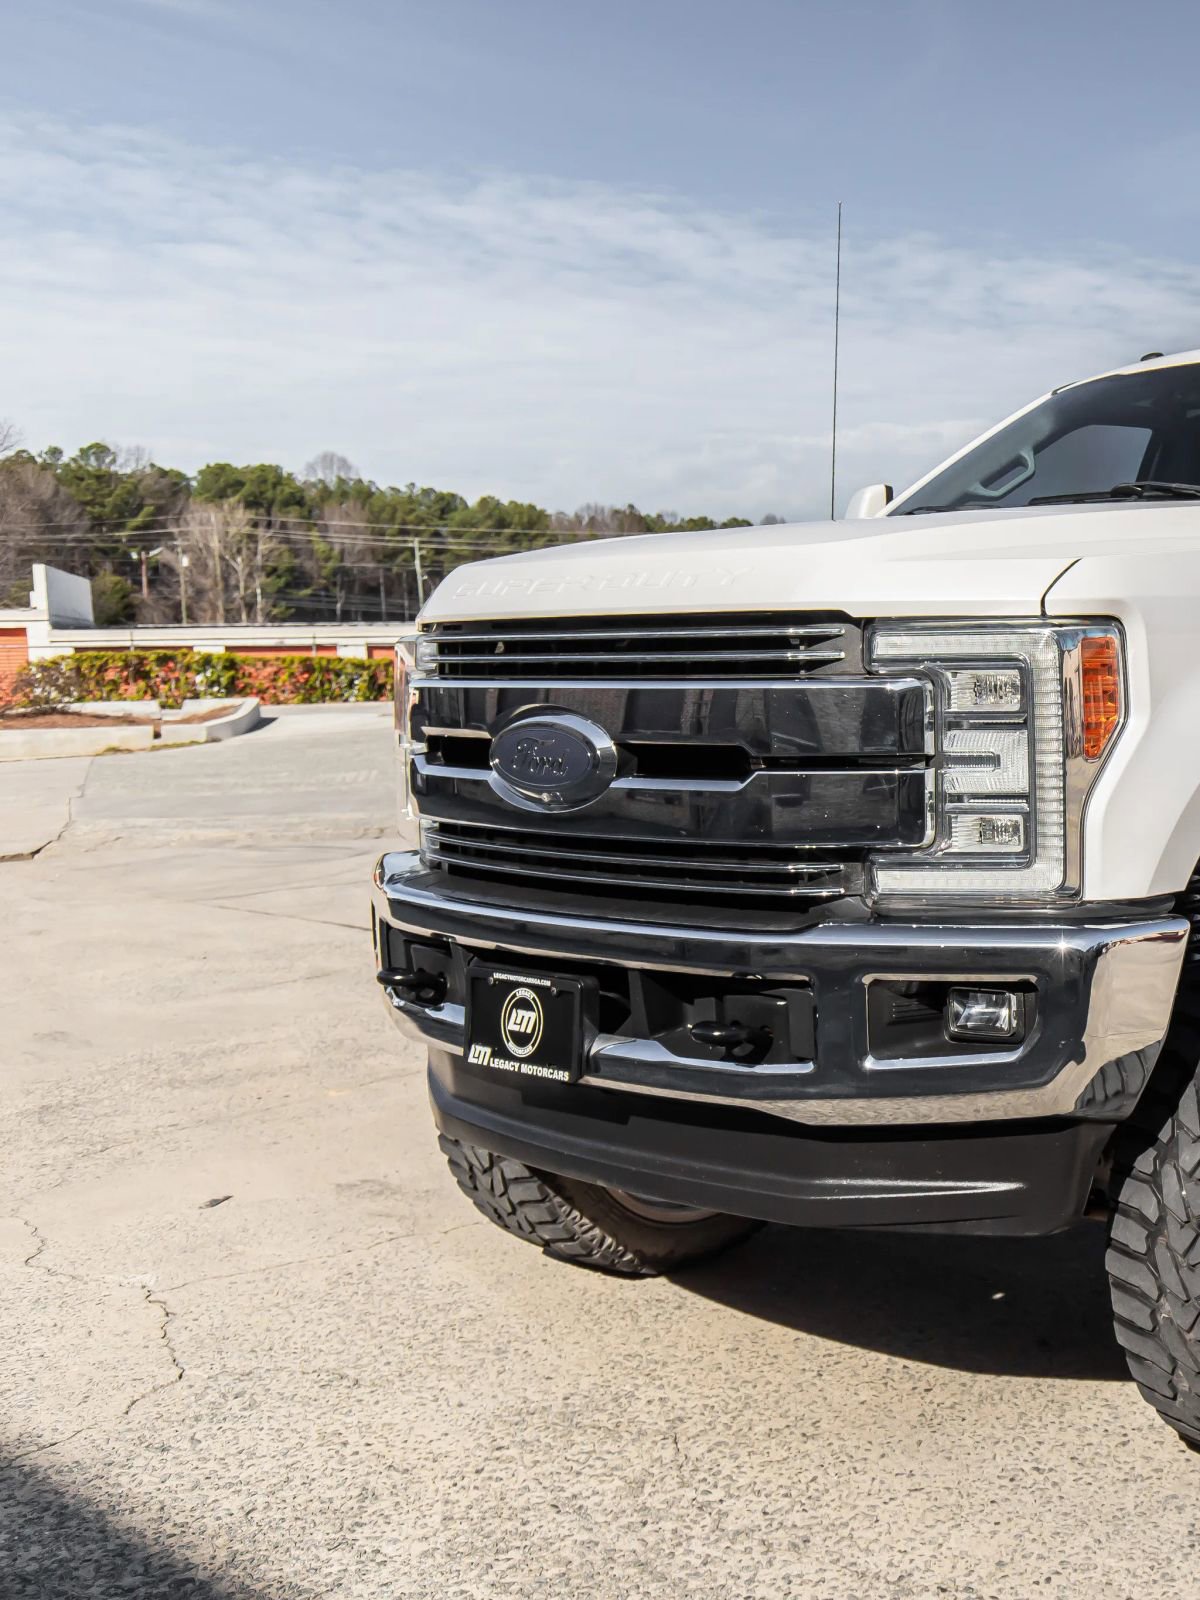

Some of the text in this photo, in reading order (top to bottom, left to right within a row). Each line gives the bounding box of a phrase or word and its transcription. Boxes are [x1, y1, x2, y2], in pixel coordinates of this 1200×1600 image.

[452, 566, 754, 600] SUPER DUTY
[511, 737, 569, 777] Ford
[515, 989, 534, 1000] LEGACY
[490, 1057, 520, 1072] LEGACY
[520, 1063, 569, 1081] MOTORCARS
